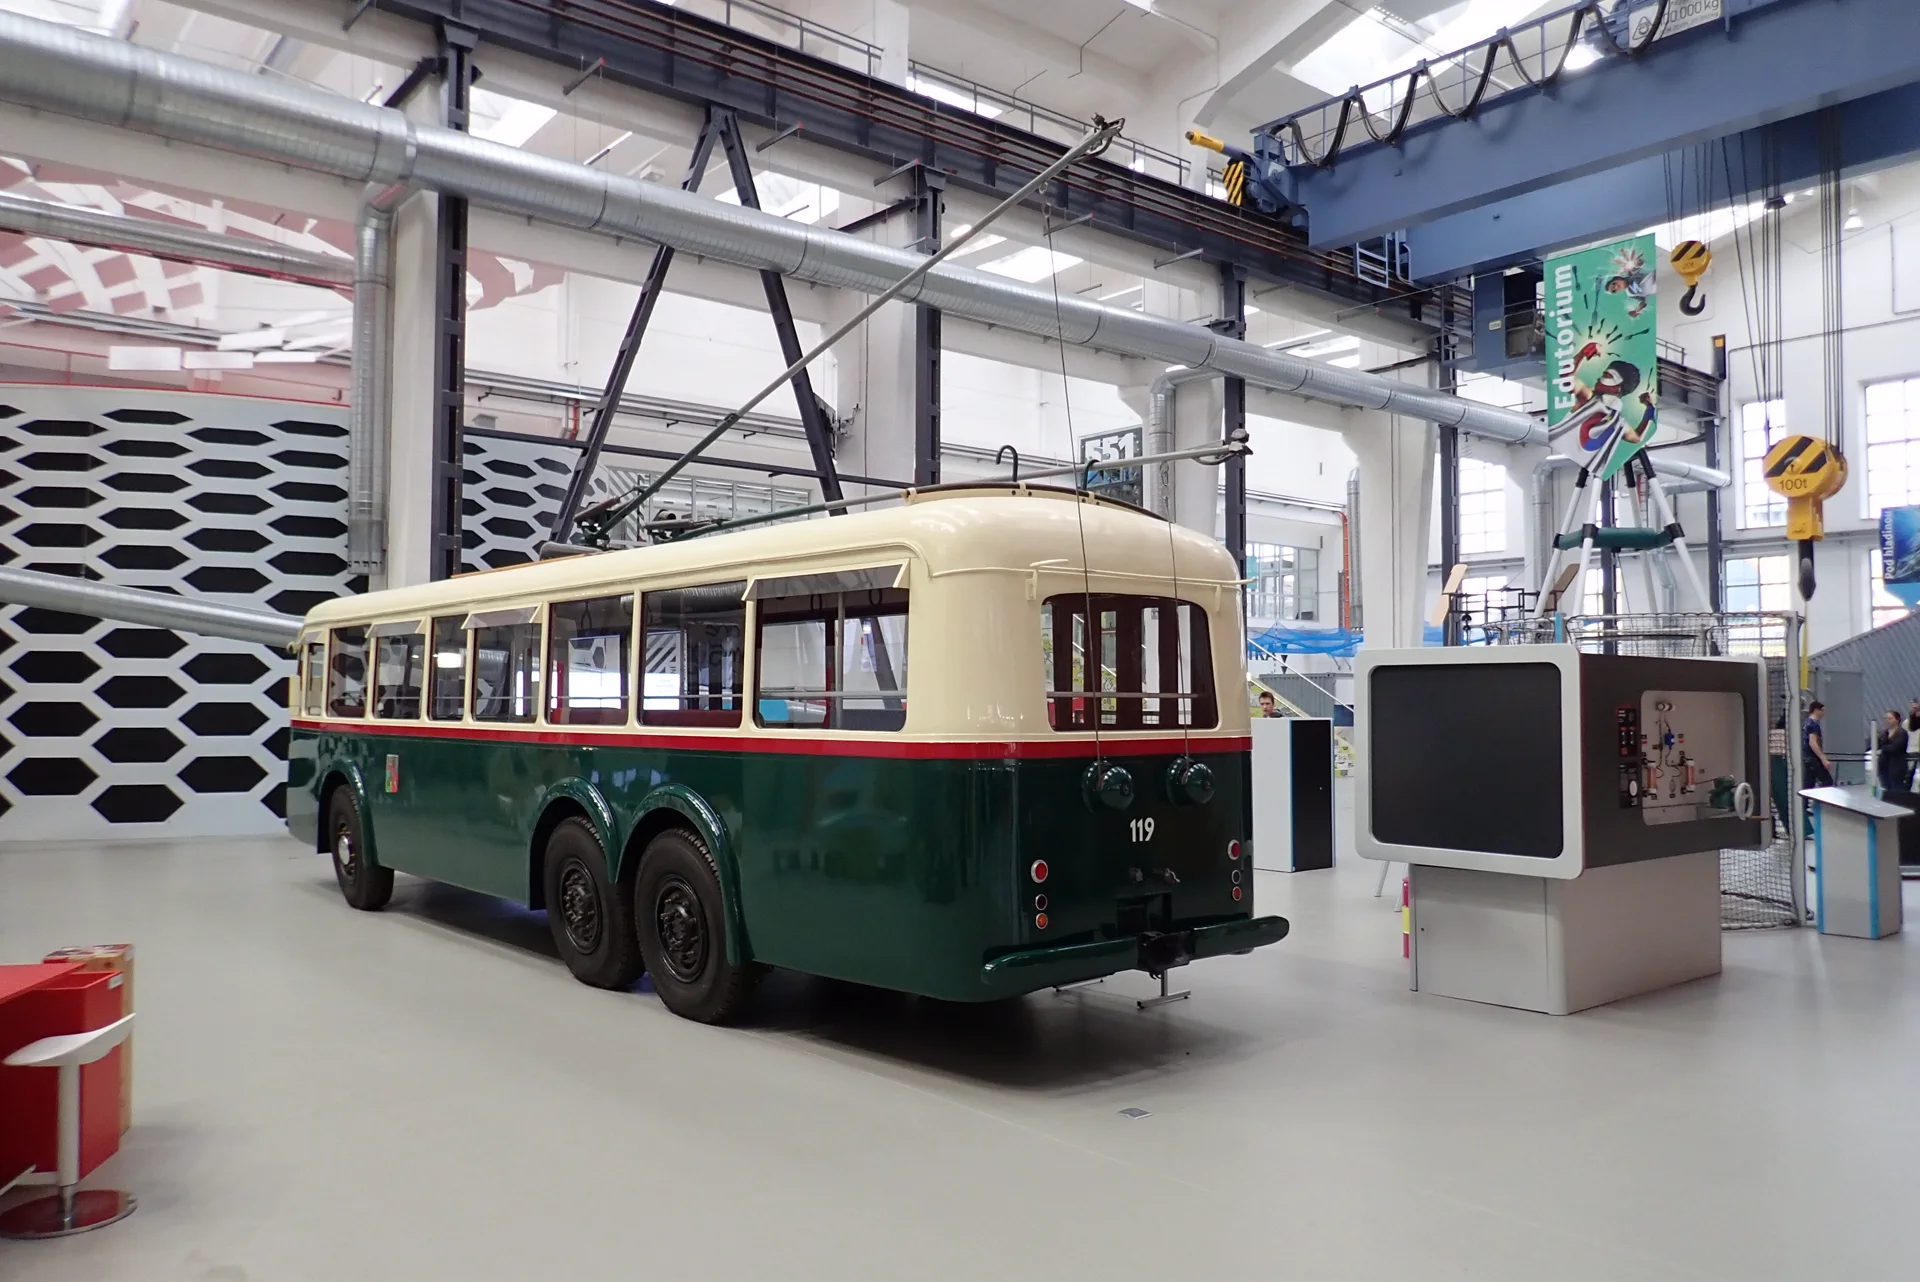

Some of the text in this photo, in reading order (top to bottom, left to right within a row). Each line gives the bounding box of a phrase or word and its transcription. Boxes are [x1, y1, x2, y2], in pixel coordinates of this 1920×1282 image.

[1660, 1, 1702, 26] 00.000
[1703, 0, 1719, 11] kg
[1549, 264, 1576, 410] Edutorium
[1085, 432, 1134, 463] 551
[1778, 478, 1807, 491] 100t
[1881, 511, 1895, 579] Pod hladinou
[1129, 817, 1155, 842] 119
